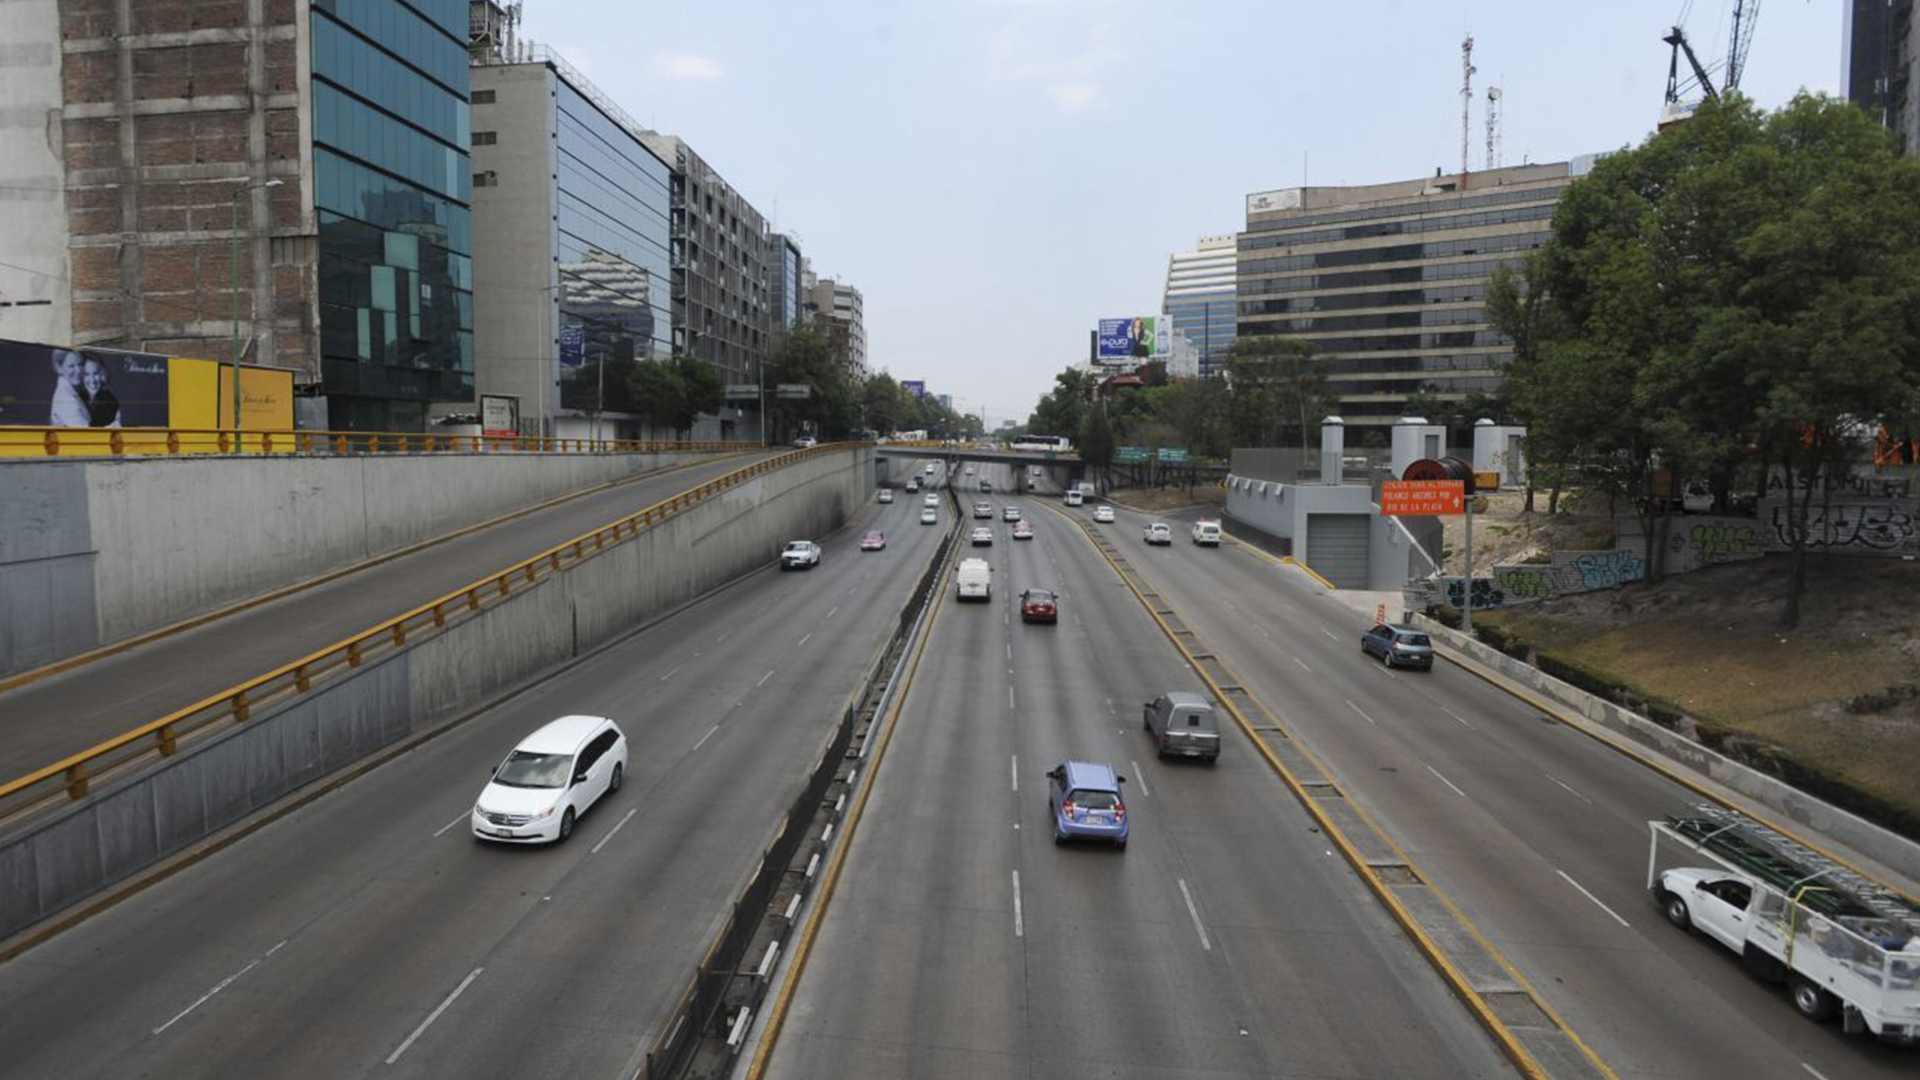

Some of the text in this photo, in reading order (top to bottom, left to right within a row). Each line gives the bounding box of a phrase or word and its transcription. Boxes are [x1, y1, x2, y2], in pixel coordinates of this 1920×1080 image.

[1400, 503, 1408, 512] DE
[1410, 503, 1420, 512] LA
[1422, 503, 1443, 512] PLATA
